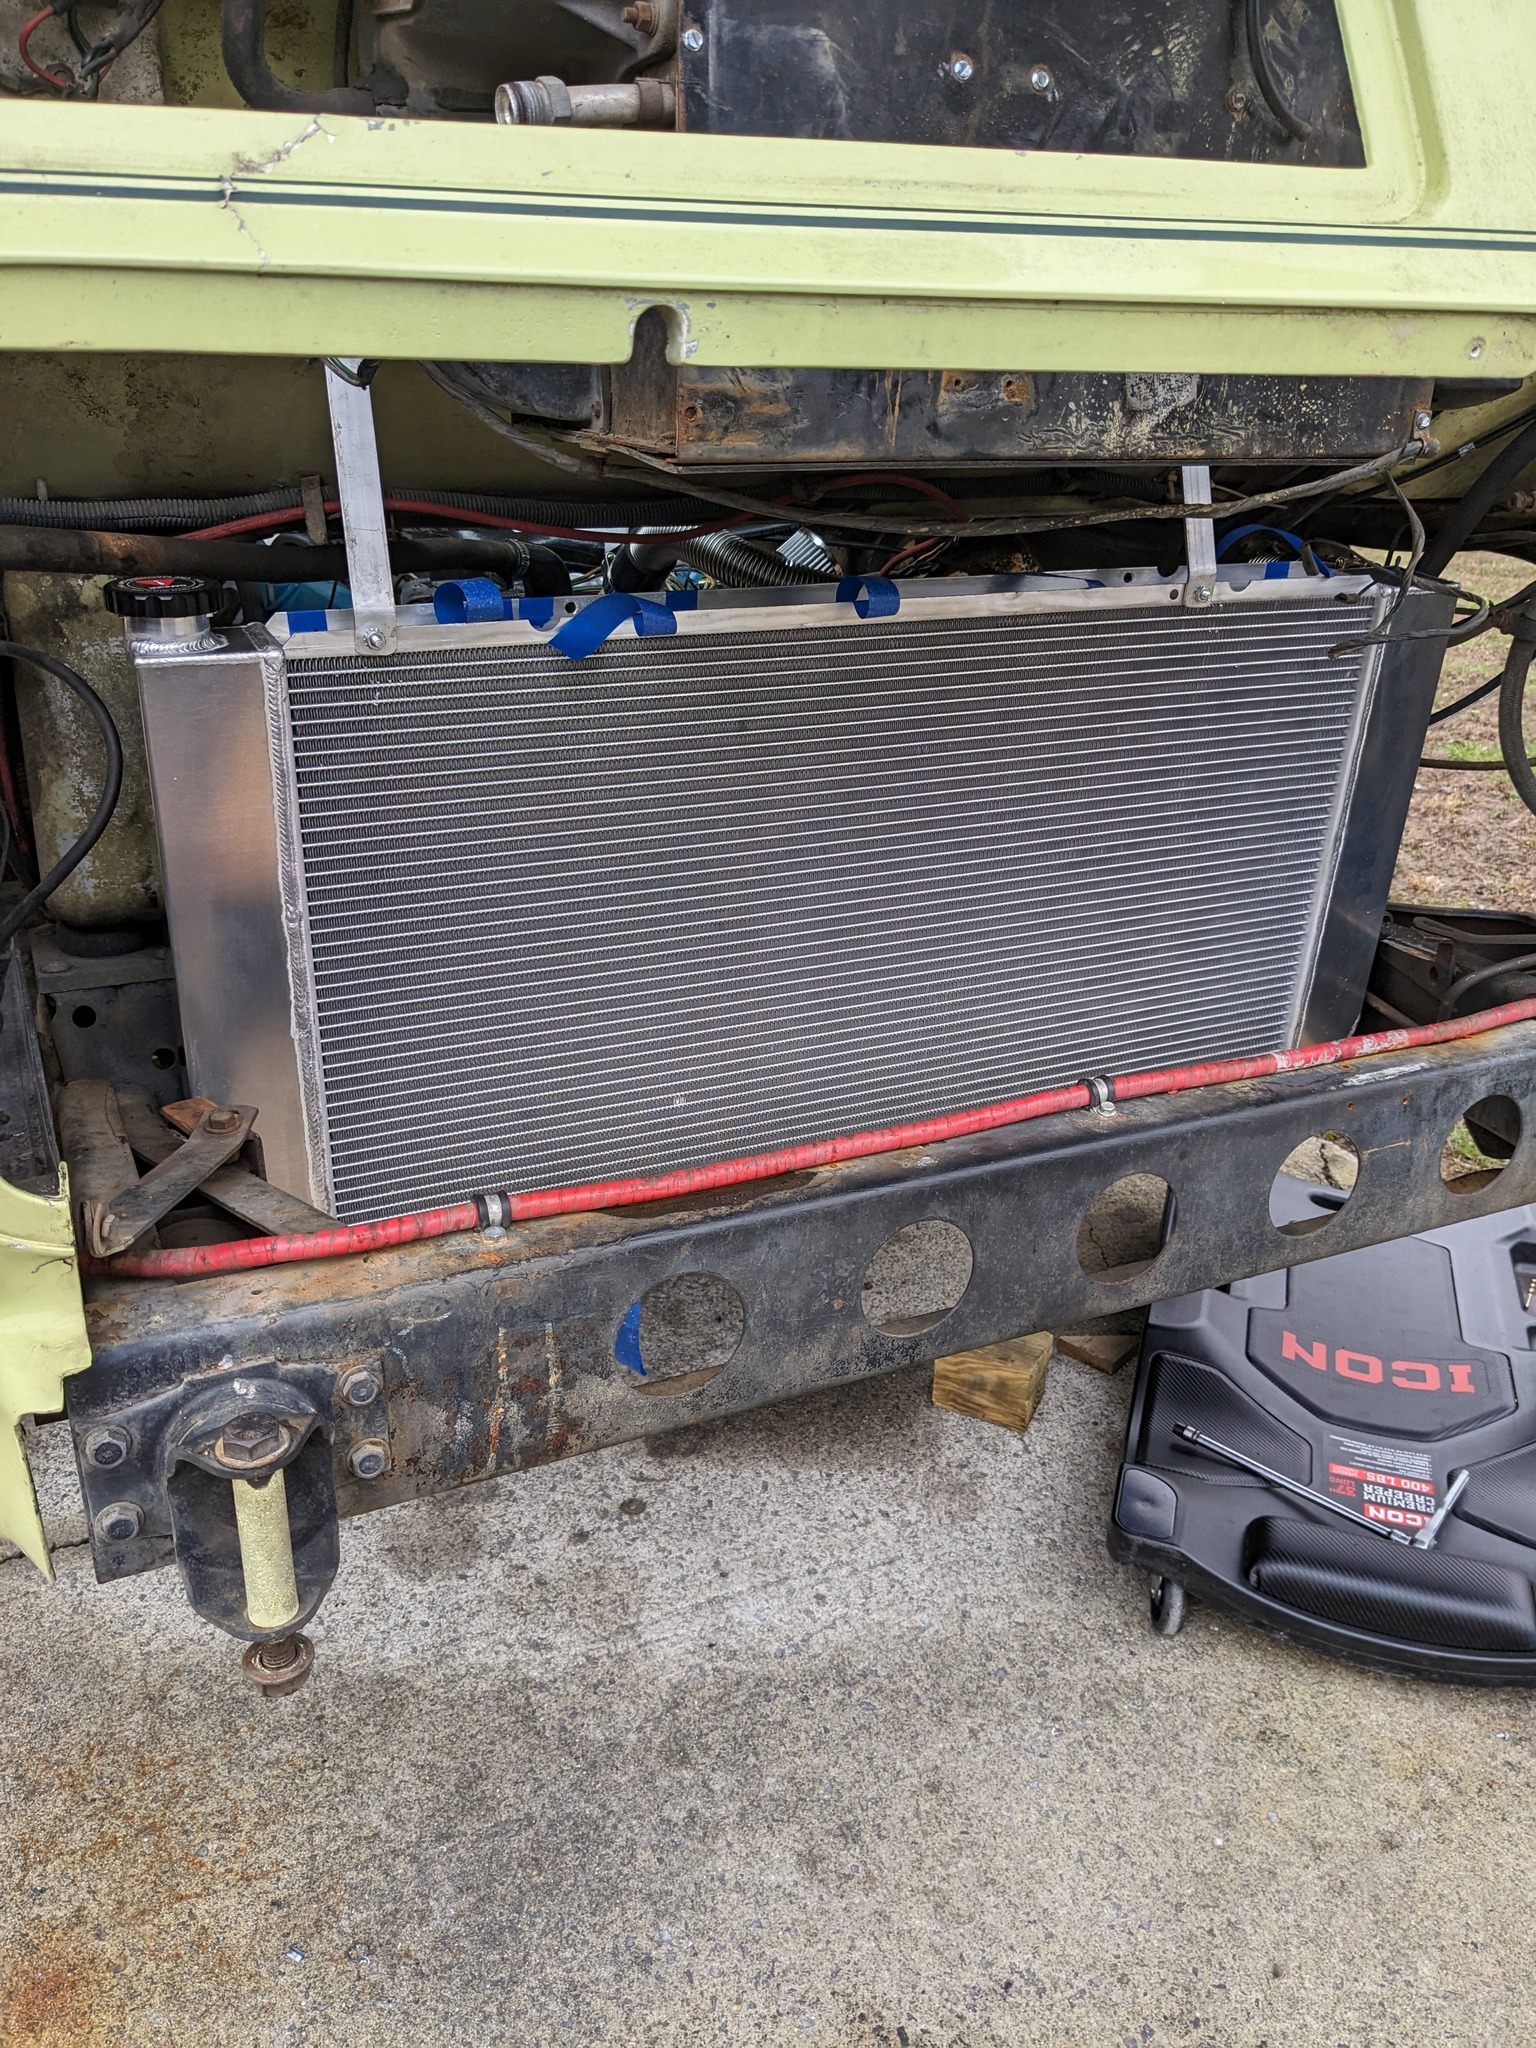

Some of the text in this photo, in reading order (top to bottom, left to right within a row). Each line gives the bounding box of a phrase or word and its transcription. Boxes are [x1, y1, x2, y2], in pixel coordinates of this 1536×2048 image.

[1282, 1330, 1475, 1393] ICON
[1329, 1476, 1355, 1487] LONG
[1401, 1479, 1430, 1493] 400
[1363, 1483, 1436, 1506] CREEPER
[1363, 1491, 1435, 1513] PREMIUM
